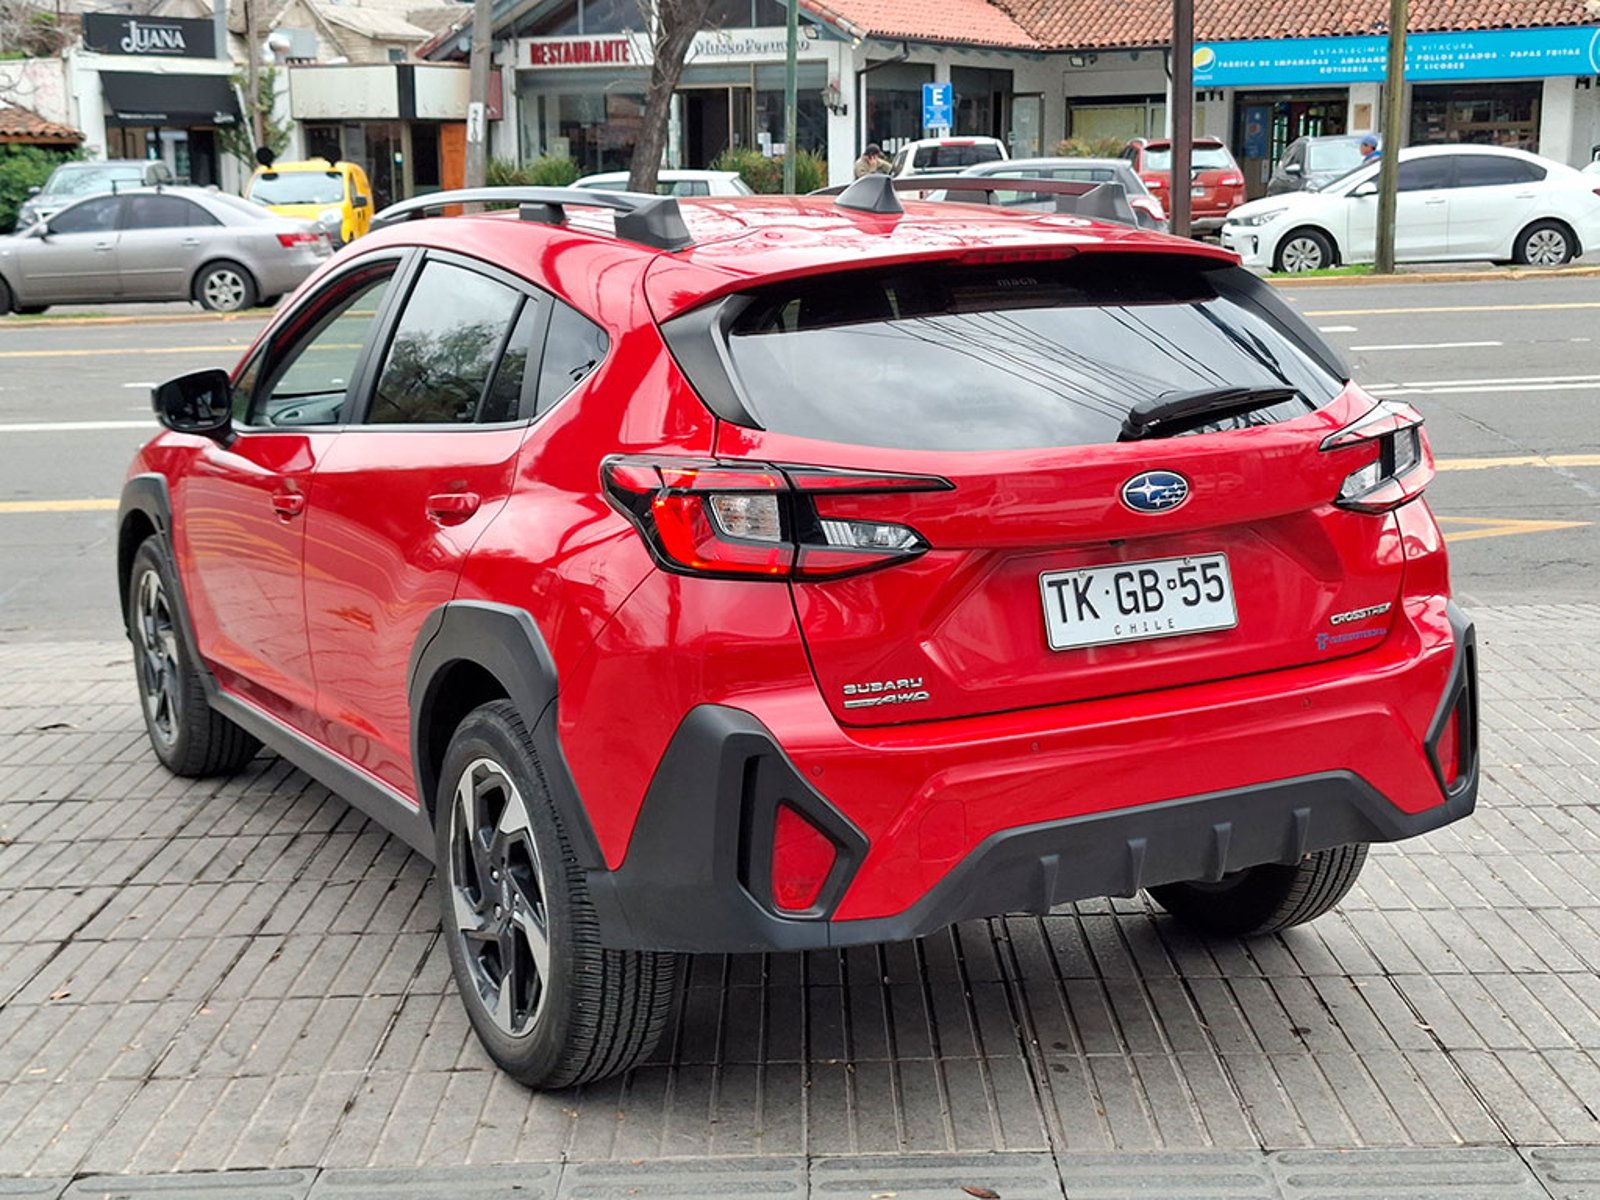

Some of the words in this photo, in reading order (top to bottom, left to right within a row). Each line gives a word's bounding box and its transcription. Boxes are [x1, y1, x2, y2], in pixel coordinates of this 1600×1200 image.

[530, 40, 630, 65] RESTAURANTE
[1274, 58, 1329, 66] EMPANADAS
[1417, 53, 1454, 61] POLLOS
[1458, 51, 1497, 60] ASADOS
[1510, 50, 1541, 58] PAPAS
[1546, 48, 1580, 56] FRITAS
[1424, 61, 1464, 70] LICORES
[932, 88, 944, 106] E
[1113, 618, 1175, 635] CHILE
[843, 677, 923, 695] SUBARU
